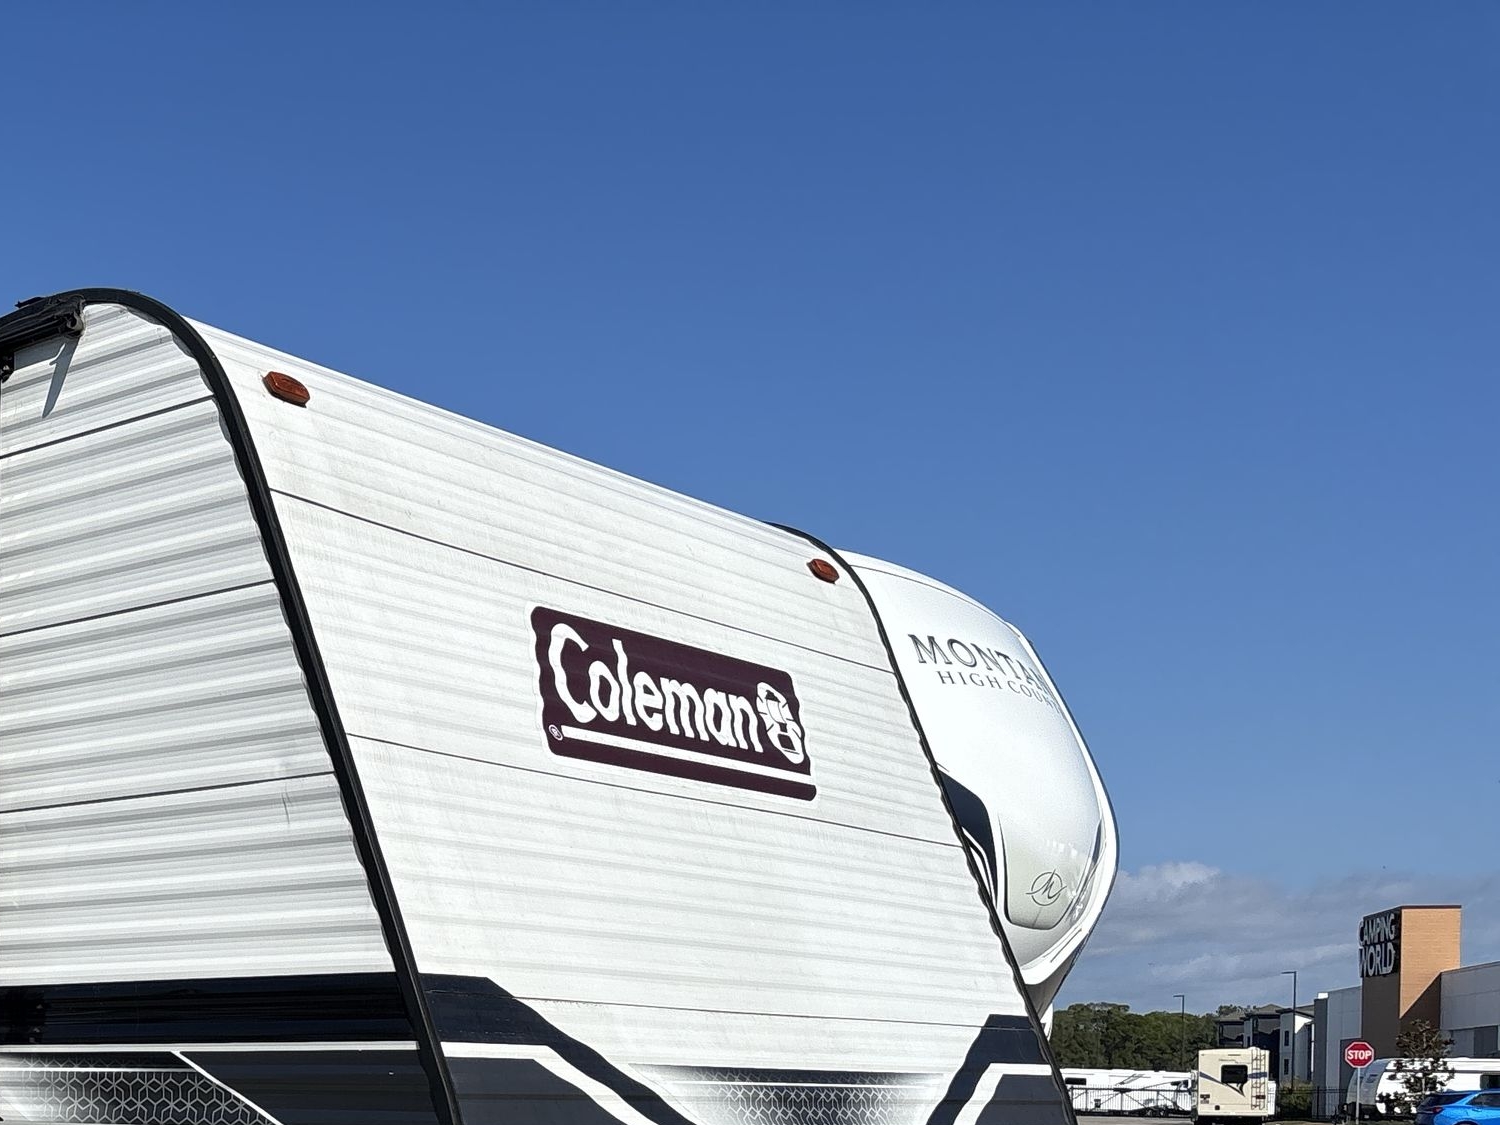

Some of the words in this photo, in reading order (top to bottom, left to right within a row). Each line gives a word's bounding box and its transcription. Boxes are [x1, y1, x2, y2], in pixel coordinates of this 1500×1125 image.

[907, 633, 1056, 698] MONTAN
[936, 670, 1003, 690] HIGH
[548, 622, 764, 753] Coleman
[1357, 912, 1395, 946] CAMPING
[1358, 941, 1396, 978] WORLD
[1347, 1050, 1372, 1060] STOP
